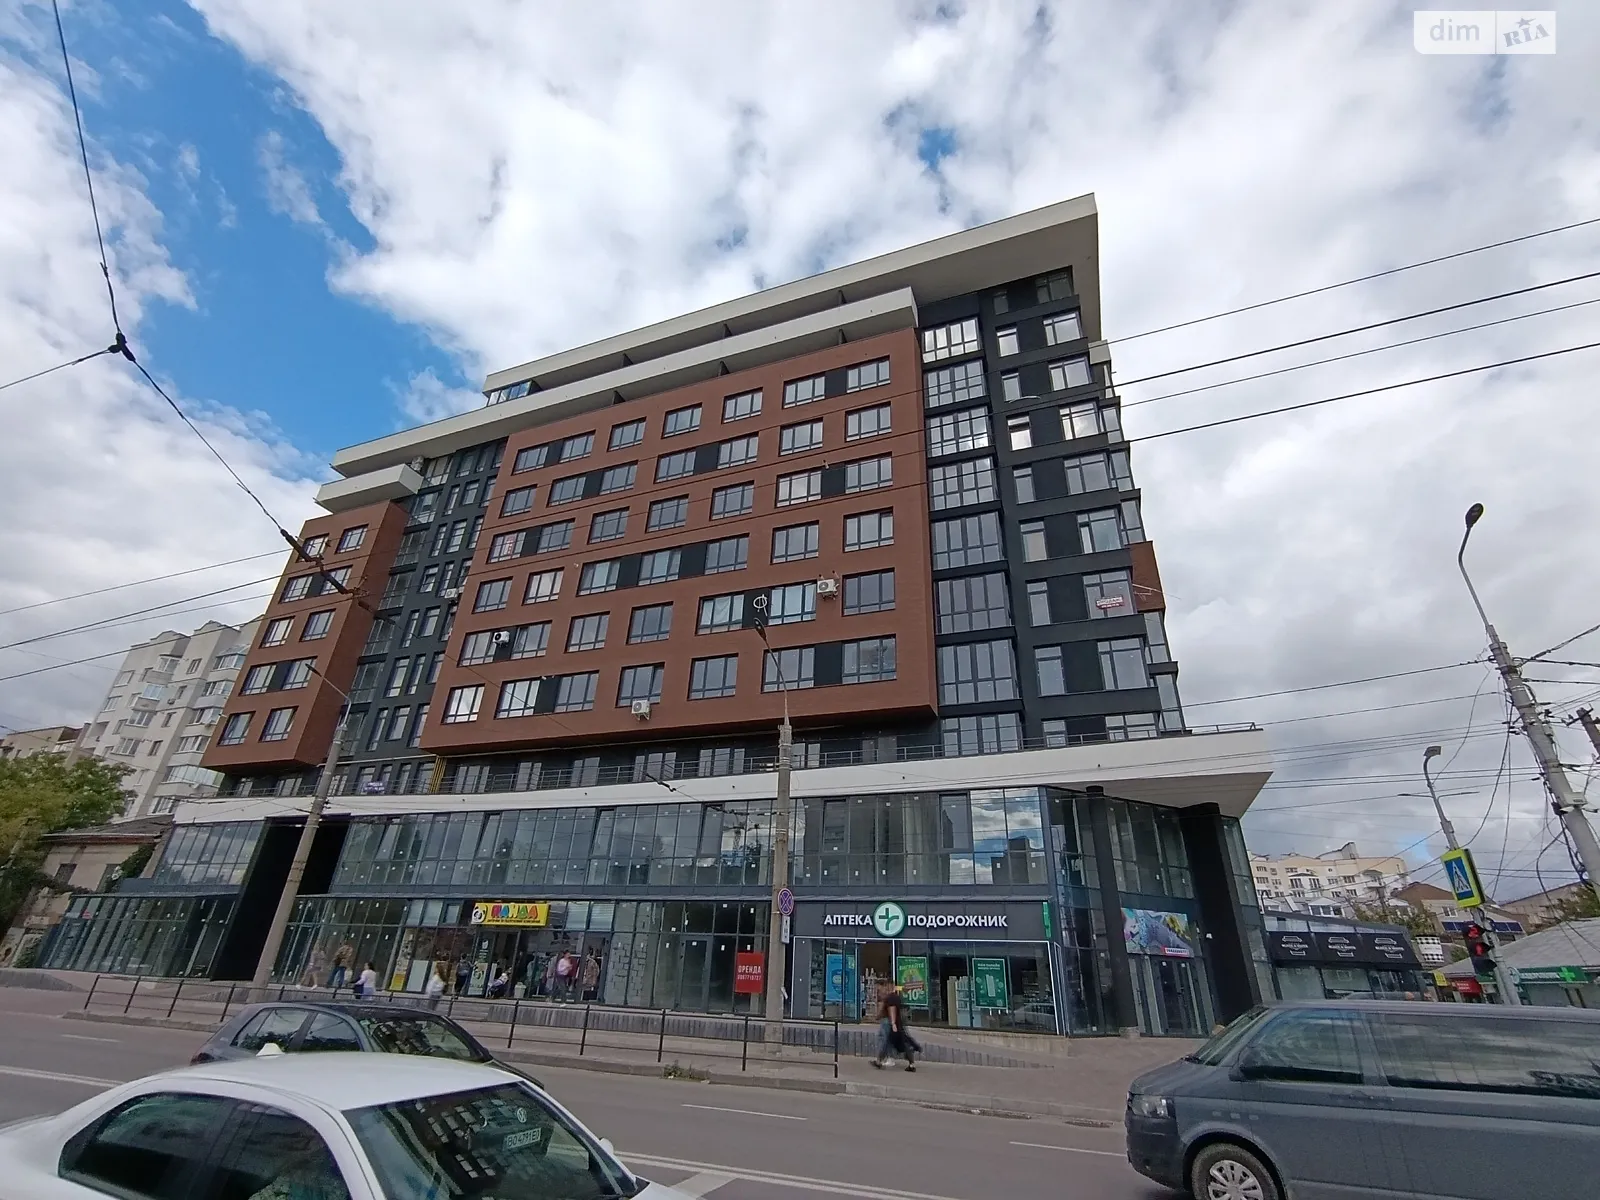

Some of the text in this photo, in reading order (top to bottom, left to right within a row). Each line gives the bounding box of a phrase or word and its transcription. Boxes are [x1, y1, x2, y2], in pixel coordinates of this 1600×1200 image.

[823, 914, 1009, 928] АПТЕКА ПОДОРОЖНИК
[737, 965, 762, 974] ОРЕНДА
